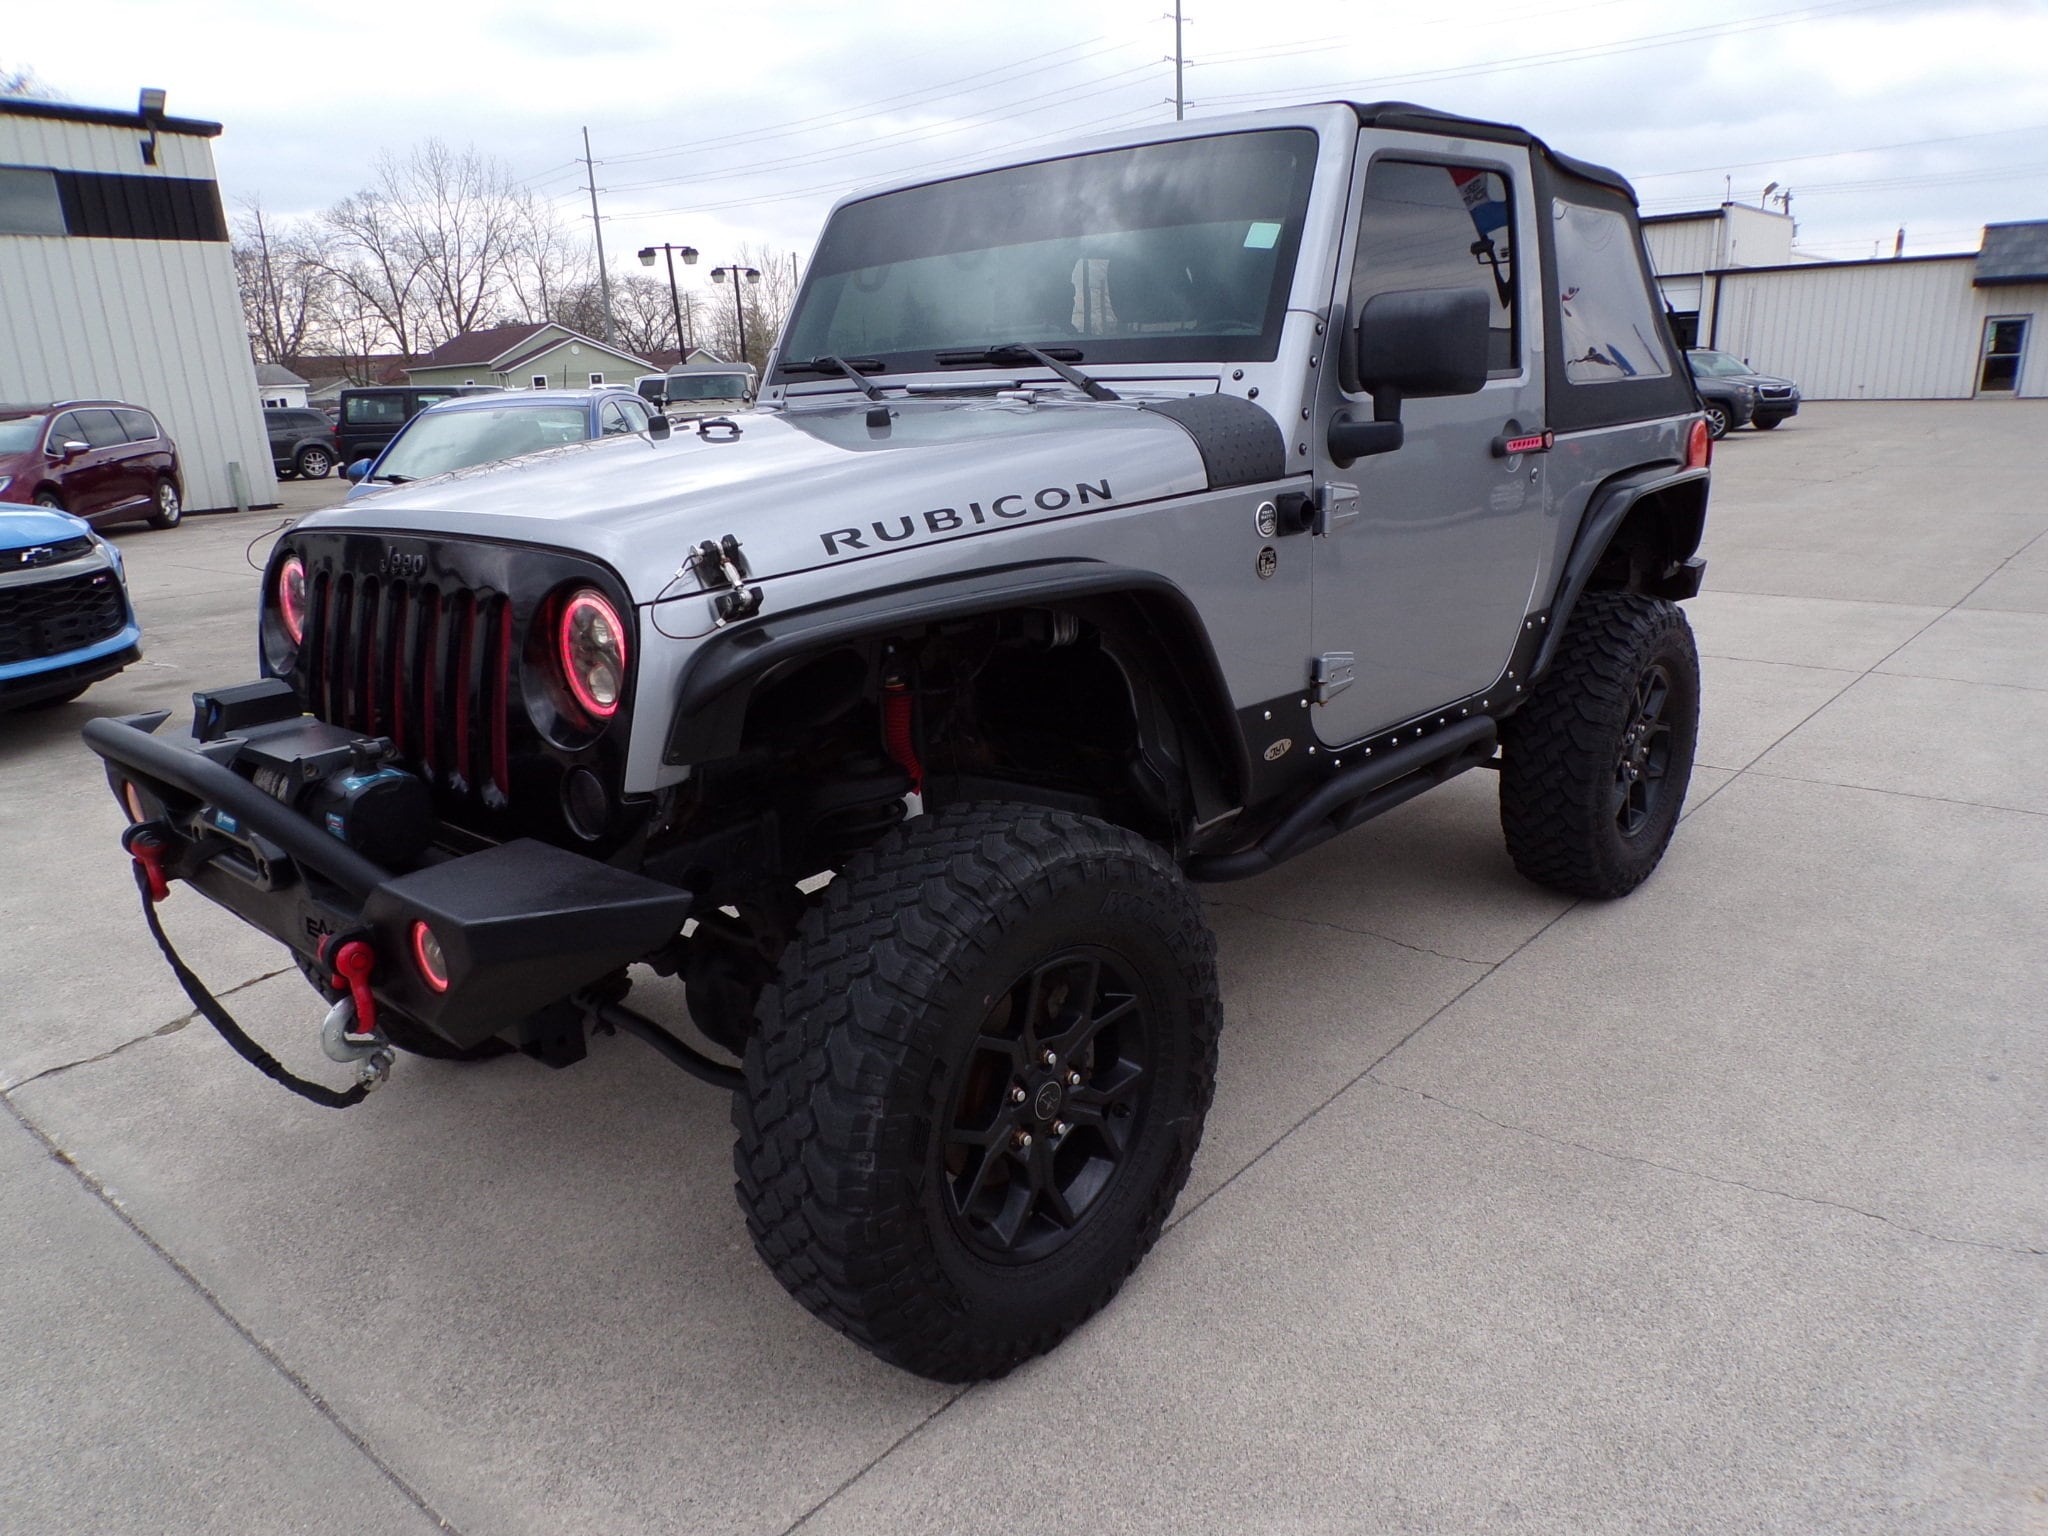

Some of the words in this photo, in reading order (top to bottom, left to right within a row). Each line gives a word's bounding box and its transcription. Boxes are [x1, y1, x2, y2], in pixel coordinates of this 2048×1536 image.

[820, 479, 1112, 556] RUBICON
[379, 546, 427, 577] Jeep
[306, 917, 335, 938] EA
